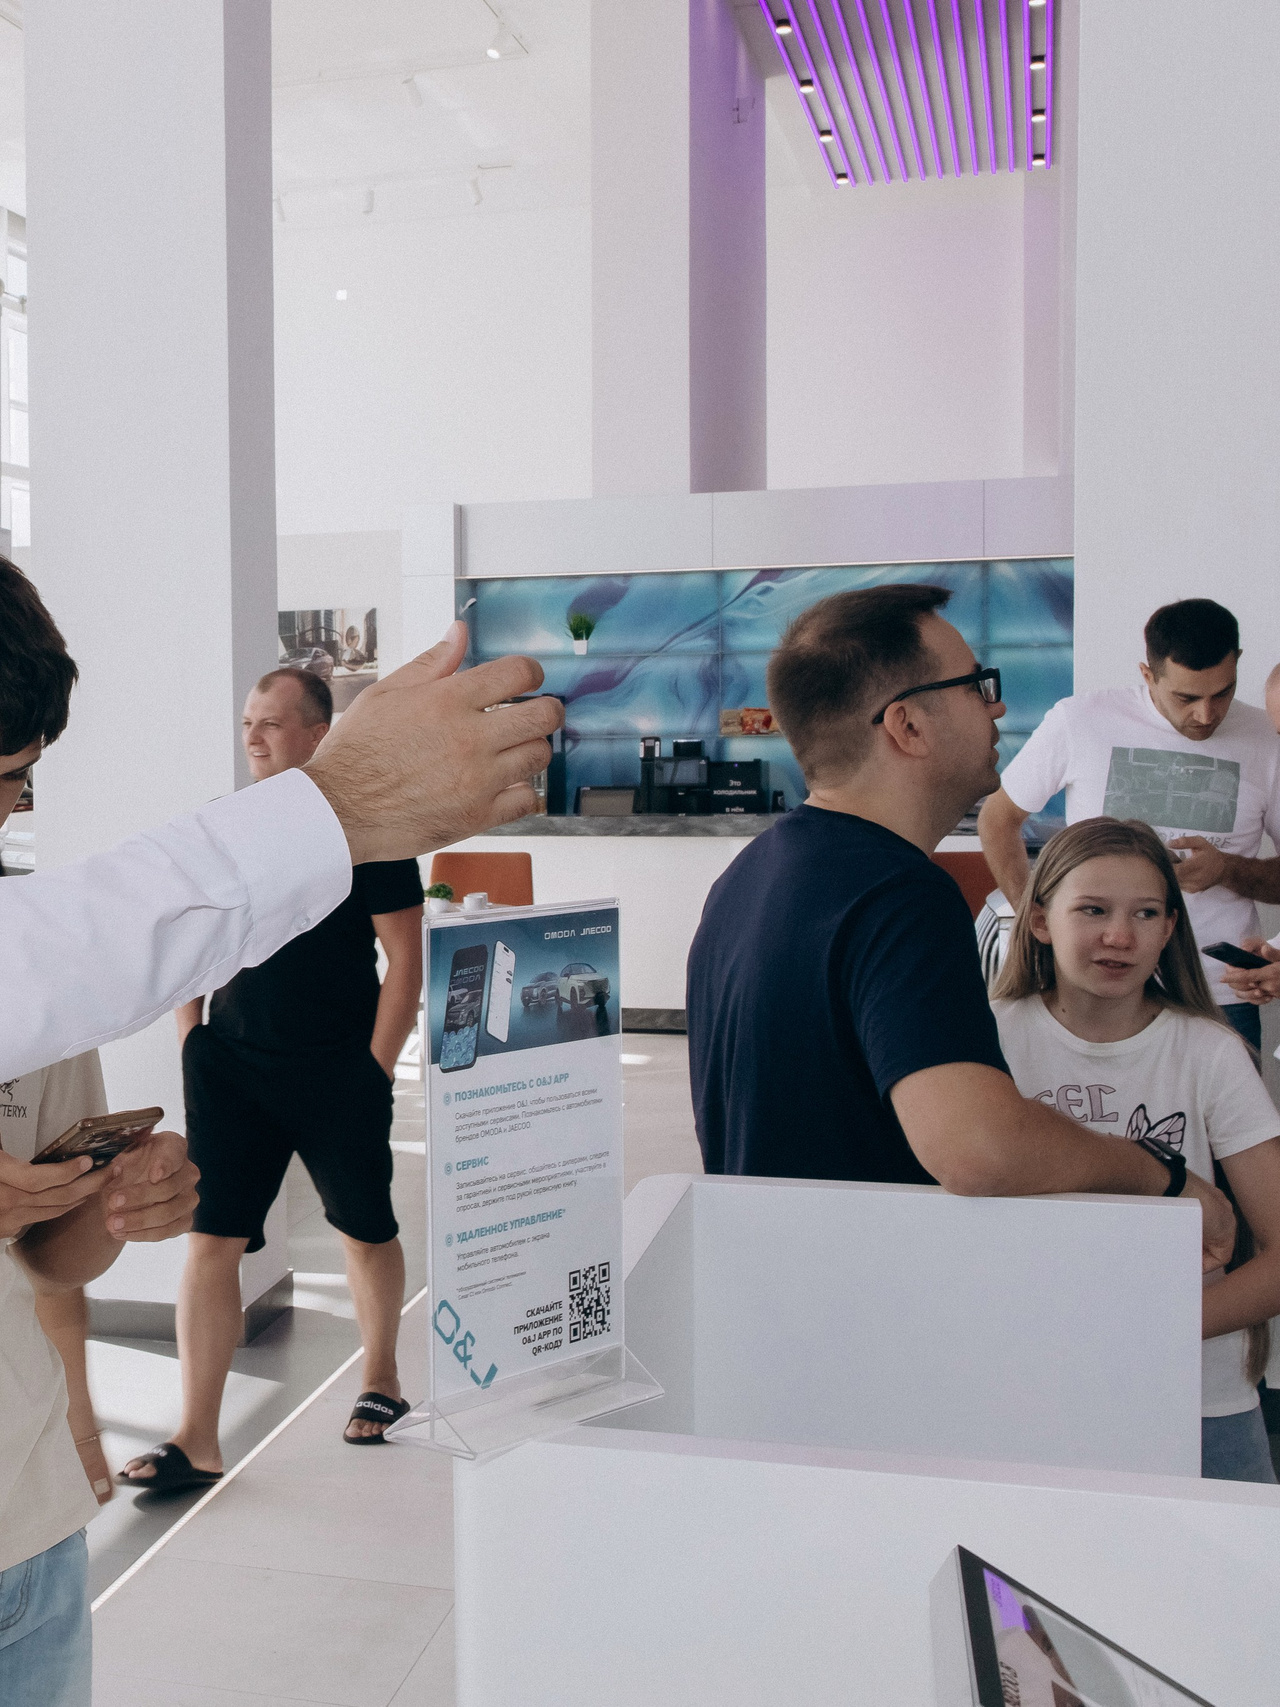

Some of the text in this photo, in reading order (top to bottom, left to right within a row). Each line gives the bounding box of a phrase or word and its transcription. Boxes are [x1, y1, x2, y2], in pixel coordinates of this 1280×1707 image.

[544, 926, 612, 940] OMODA JAECOO
[453, 964, 484, 978] JAECOO
[454, 1073, 570, 1102] ПОЗНАКОМЬТЕСЬ С O&J APP
[455, 1109, 481, 1120] Скачайте
[482, 1104, 516, 1116] приложение
[530, 1096, 546, 1106] чтобы
[546, 1091, 581, 1103] пользоваться
[455, 1119, 488, 1132] доступными
[522, 1106, 560, 1119] Познакомьтесь
[455, 1132, 479, 1143] брендов
[480, 1126, 502, 1138] OMODA
[456, 1156, 489, 1172] СЕРВИС
[456, 1176, 498, 1190] Записывайтесь
[528, 1162, 557, 1174] общайтесь
[464, 1186, 492, 1200] гарантией
[498, 1180, 530, 1191] сервисными
[482, 1196, 504, 1208] держите
[506, 1194, 516, 1202] под
[516, 1188, 532, 1200] рукой
[534, 1183, 562, 1195] сервисную
[457, 1222, 508, 1244] УДАЛЕННОЕ
[457, 1246, 489, 1260] Управляйте
[490, 1238, 526, 1252] автомобилем
[532, 1232, 550, 1242] экрана
[457, 1258, 490, 1272] мобильного
[526, 1300, 563, 1318] СКАЧАЙТЕ
[514, 1314, 563, 1335] ПРИЛОЖЕНИЕ
[522, 1326, 563, 1344] O&J APP ПО
[532, 1338, 563, 1356] QR-КОДУ
[355, 1400, 394, 1416] adidas
